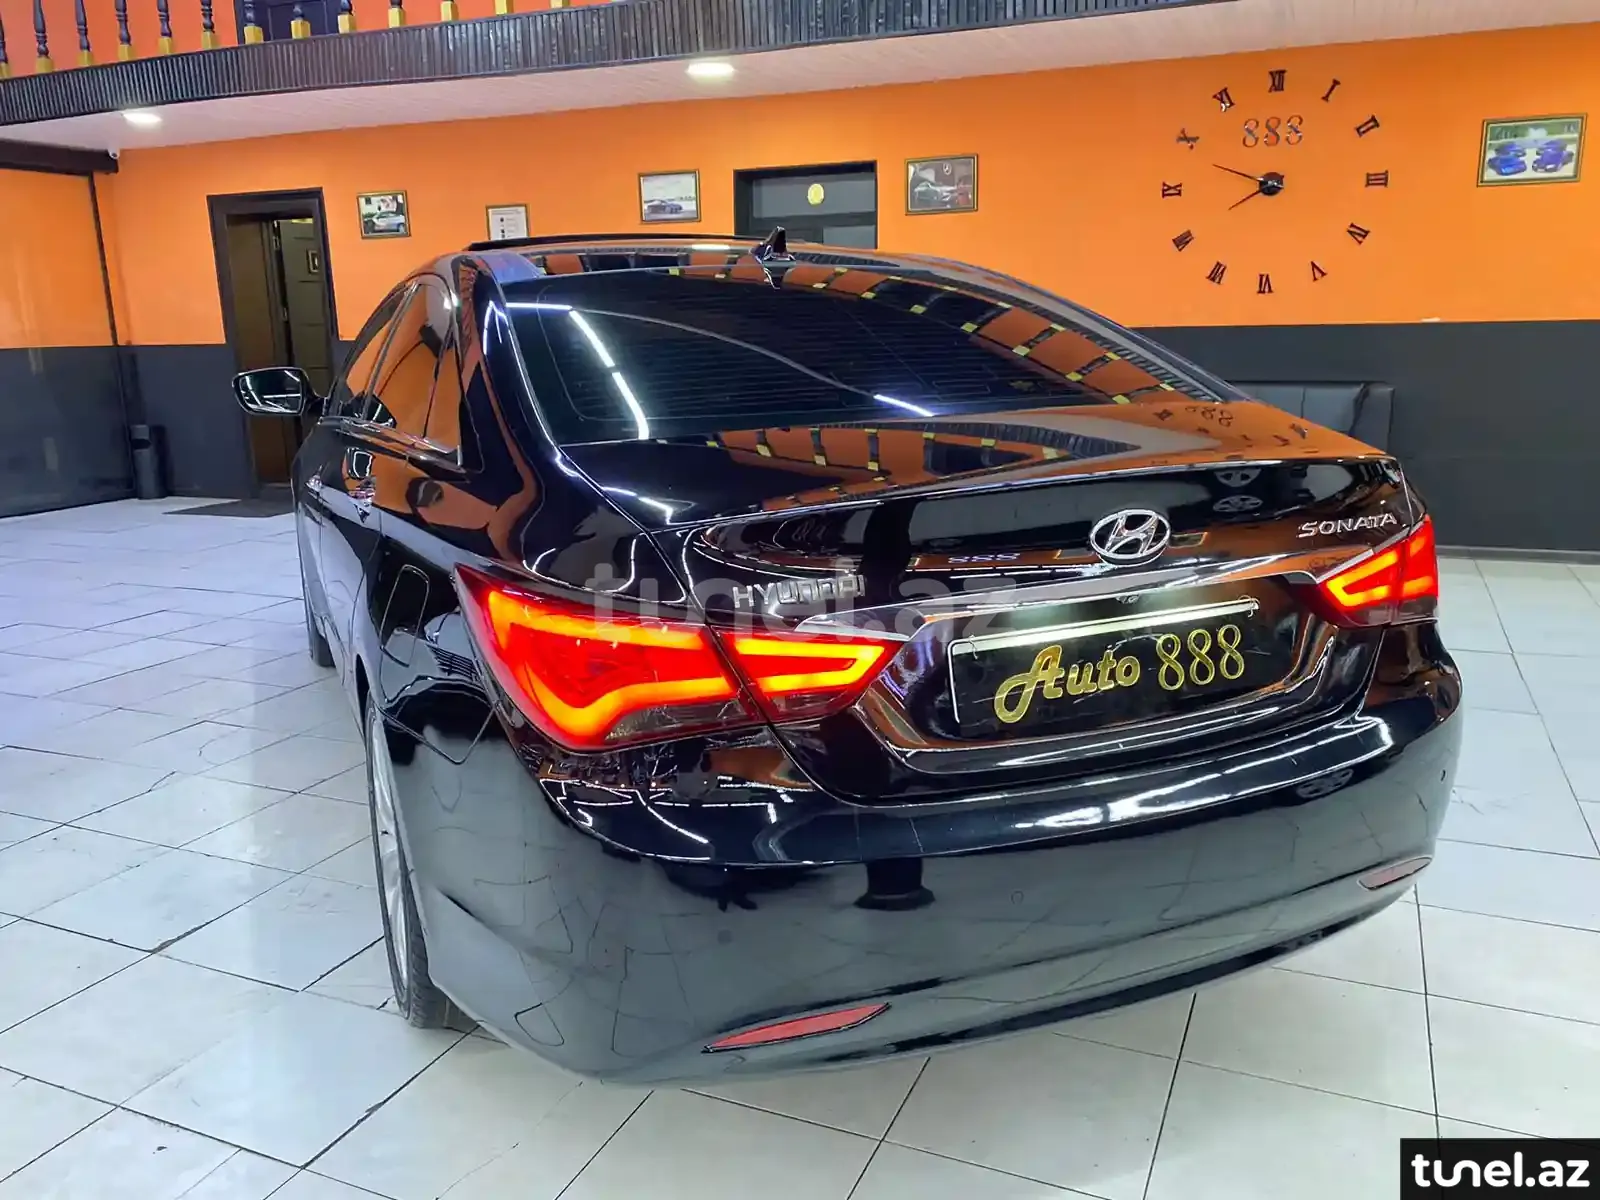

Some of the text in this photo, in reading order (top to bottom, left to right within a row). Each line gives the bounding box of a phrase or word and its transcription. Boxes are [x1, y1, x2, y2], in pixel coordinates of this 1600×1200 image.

[1268, 69, 1287, 93] XII
[1242, 114, 1304, 148] 888
[1354, 114, 1380, 138] II
[1162, 182, 1183, 198] IX
[1365, 170, 1389, 188] III
[1346, 222, 1371, 245] IV
[1257, 273, 1274, 294] VI
[1310, 261, 1328, 282] V
[1296, 513, 1398, 538] SONATA
[732, 574, 866, 609] HYUNDAI
[994, 624, 1246, 724] Auto 888
